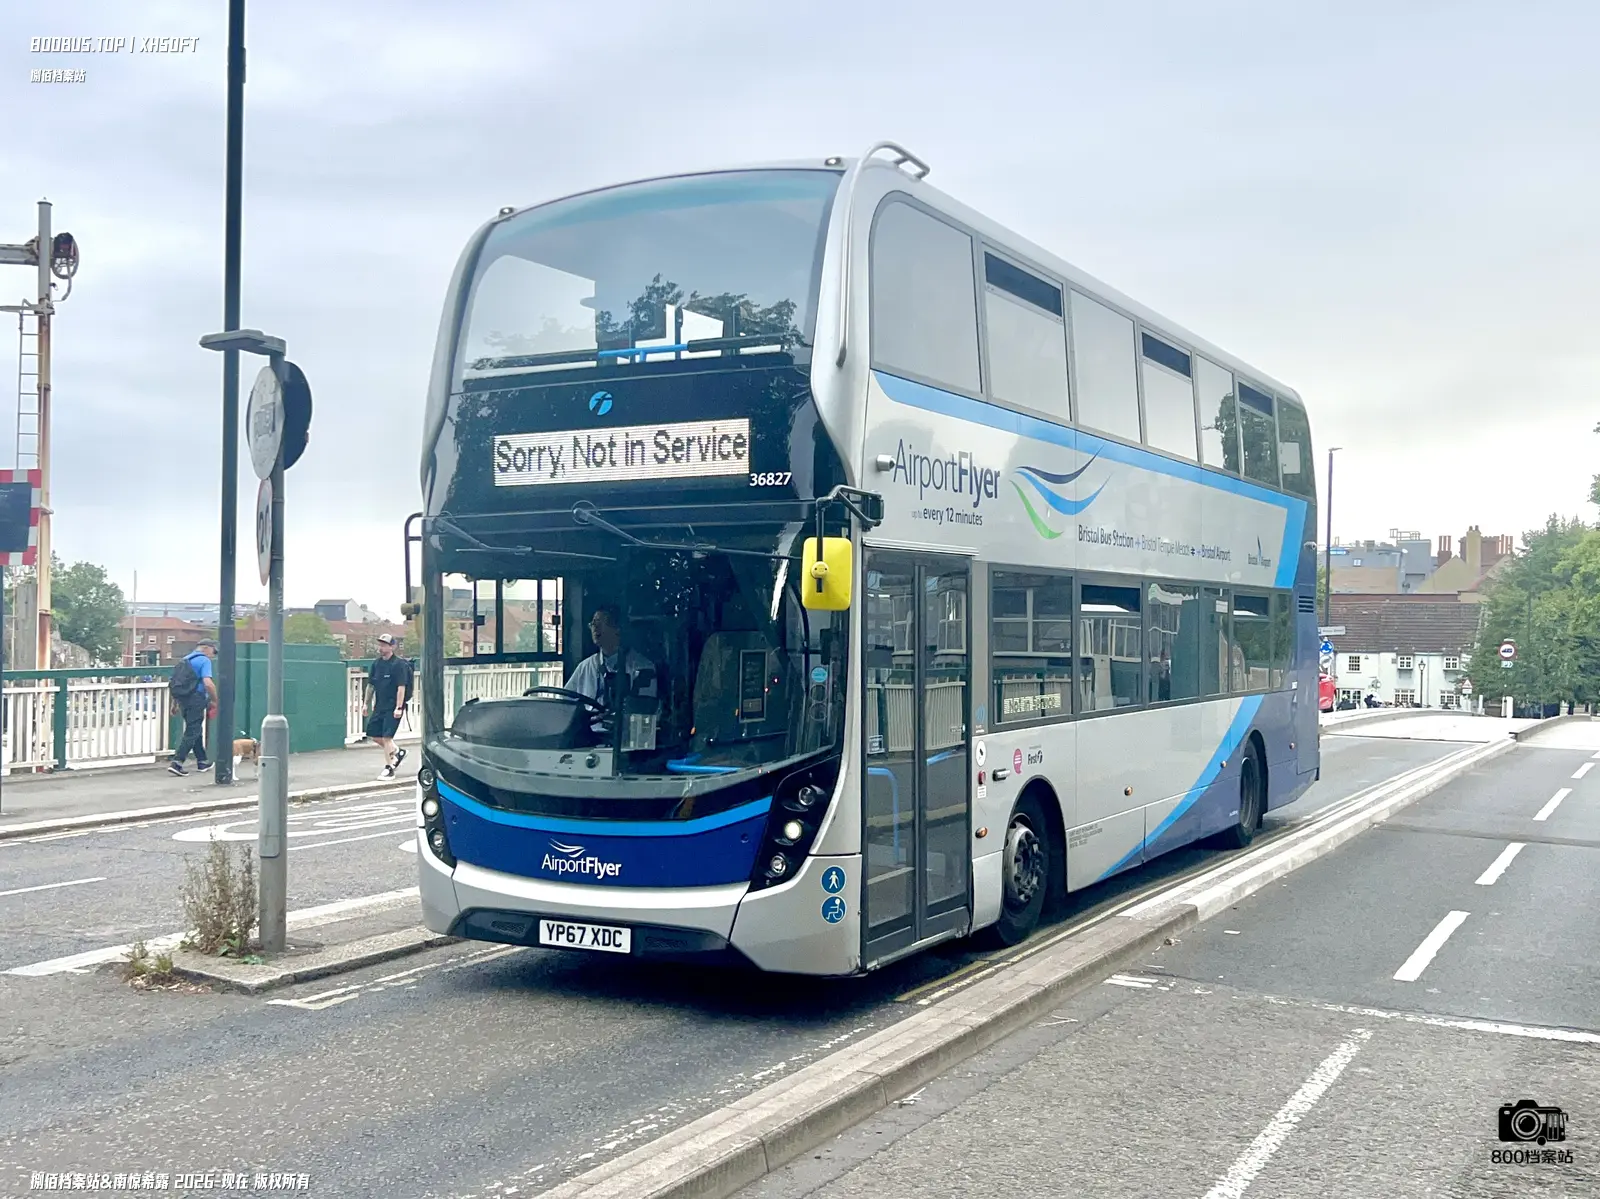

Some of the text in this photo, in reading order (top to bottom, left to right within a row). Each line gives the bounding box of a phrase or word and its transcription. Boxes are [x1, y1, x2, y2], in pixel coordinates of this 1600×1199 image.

[496, 426, 748, 479] Sorry, Not in Service
[750, 472, 792, 487] 36827
[893, 439, 1000, 508] AirportFlyer
[923, 508, 944, 525] every
[946, 507, 954, 522] 12
[955, 509, 983, 526] minutes
[1078, 524, 1099, 543] Bristol
[1101, 528, 1112, 545] Bus
[1113, 529, 1134, 548] Station
[541, 853, 622, 880] AirportFlyer
[546, 923, 623, 948] YP67 XDC
